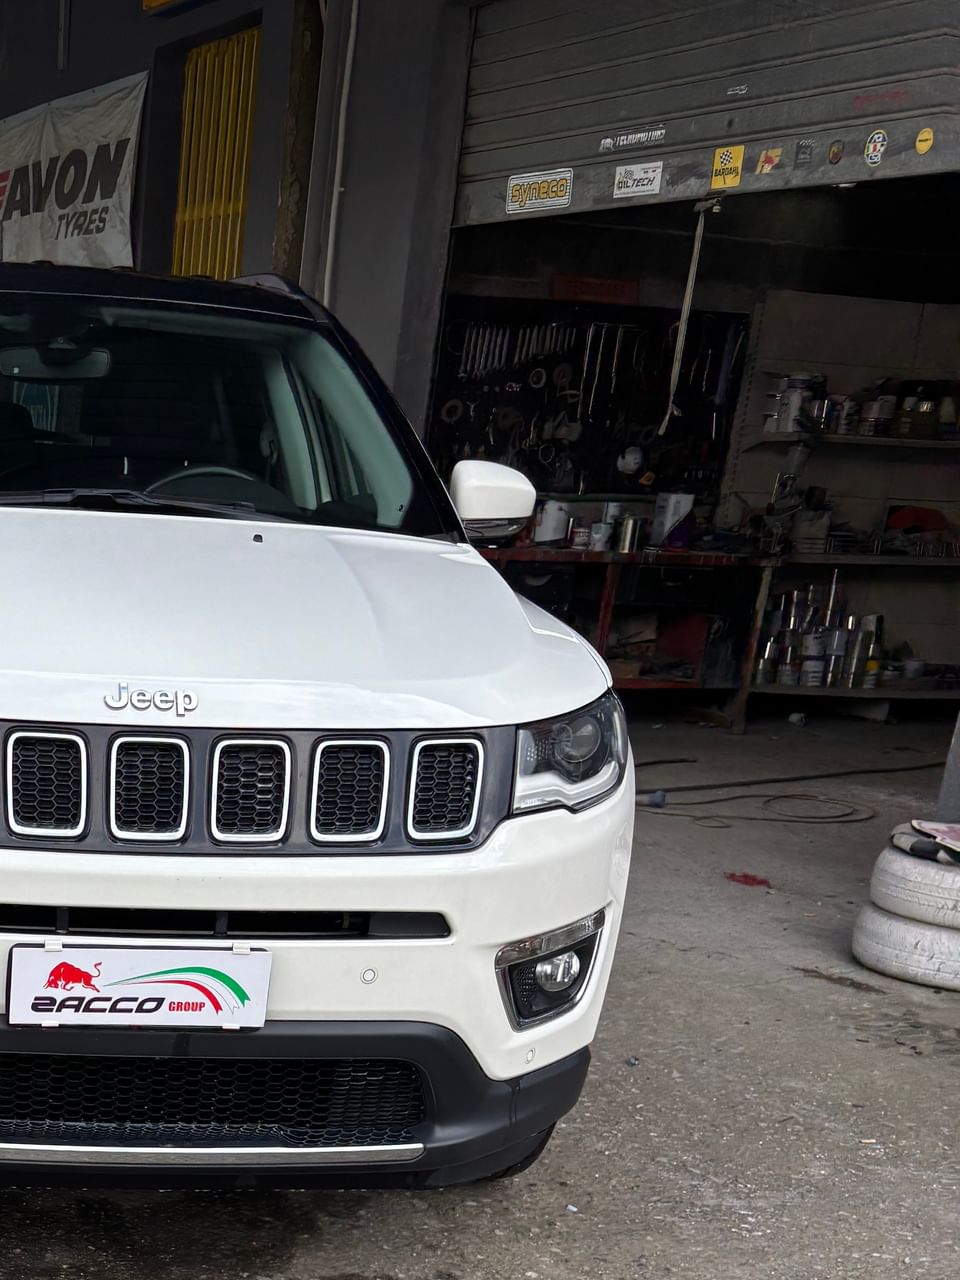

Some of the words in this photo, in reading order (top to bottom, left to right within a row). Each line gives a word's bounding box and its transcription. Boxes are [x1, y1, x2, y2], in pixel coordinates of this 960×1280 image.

[2, 138, 131, 222] AVON
[511, 178, 569, 208] syneco
[55, 206, 109, 240] TYRES
[104, 682, 199, 717] Jeep
[168, 1001, 206, 1012] GROUP
